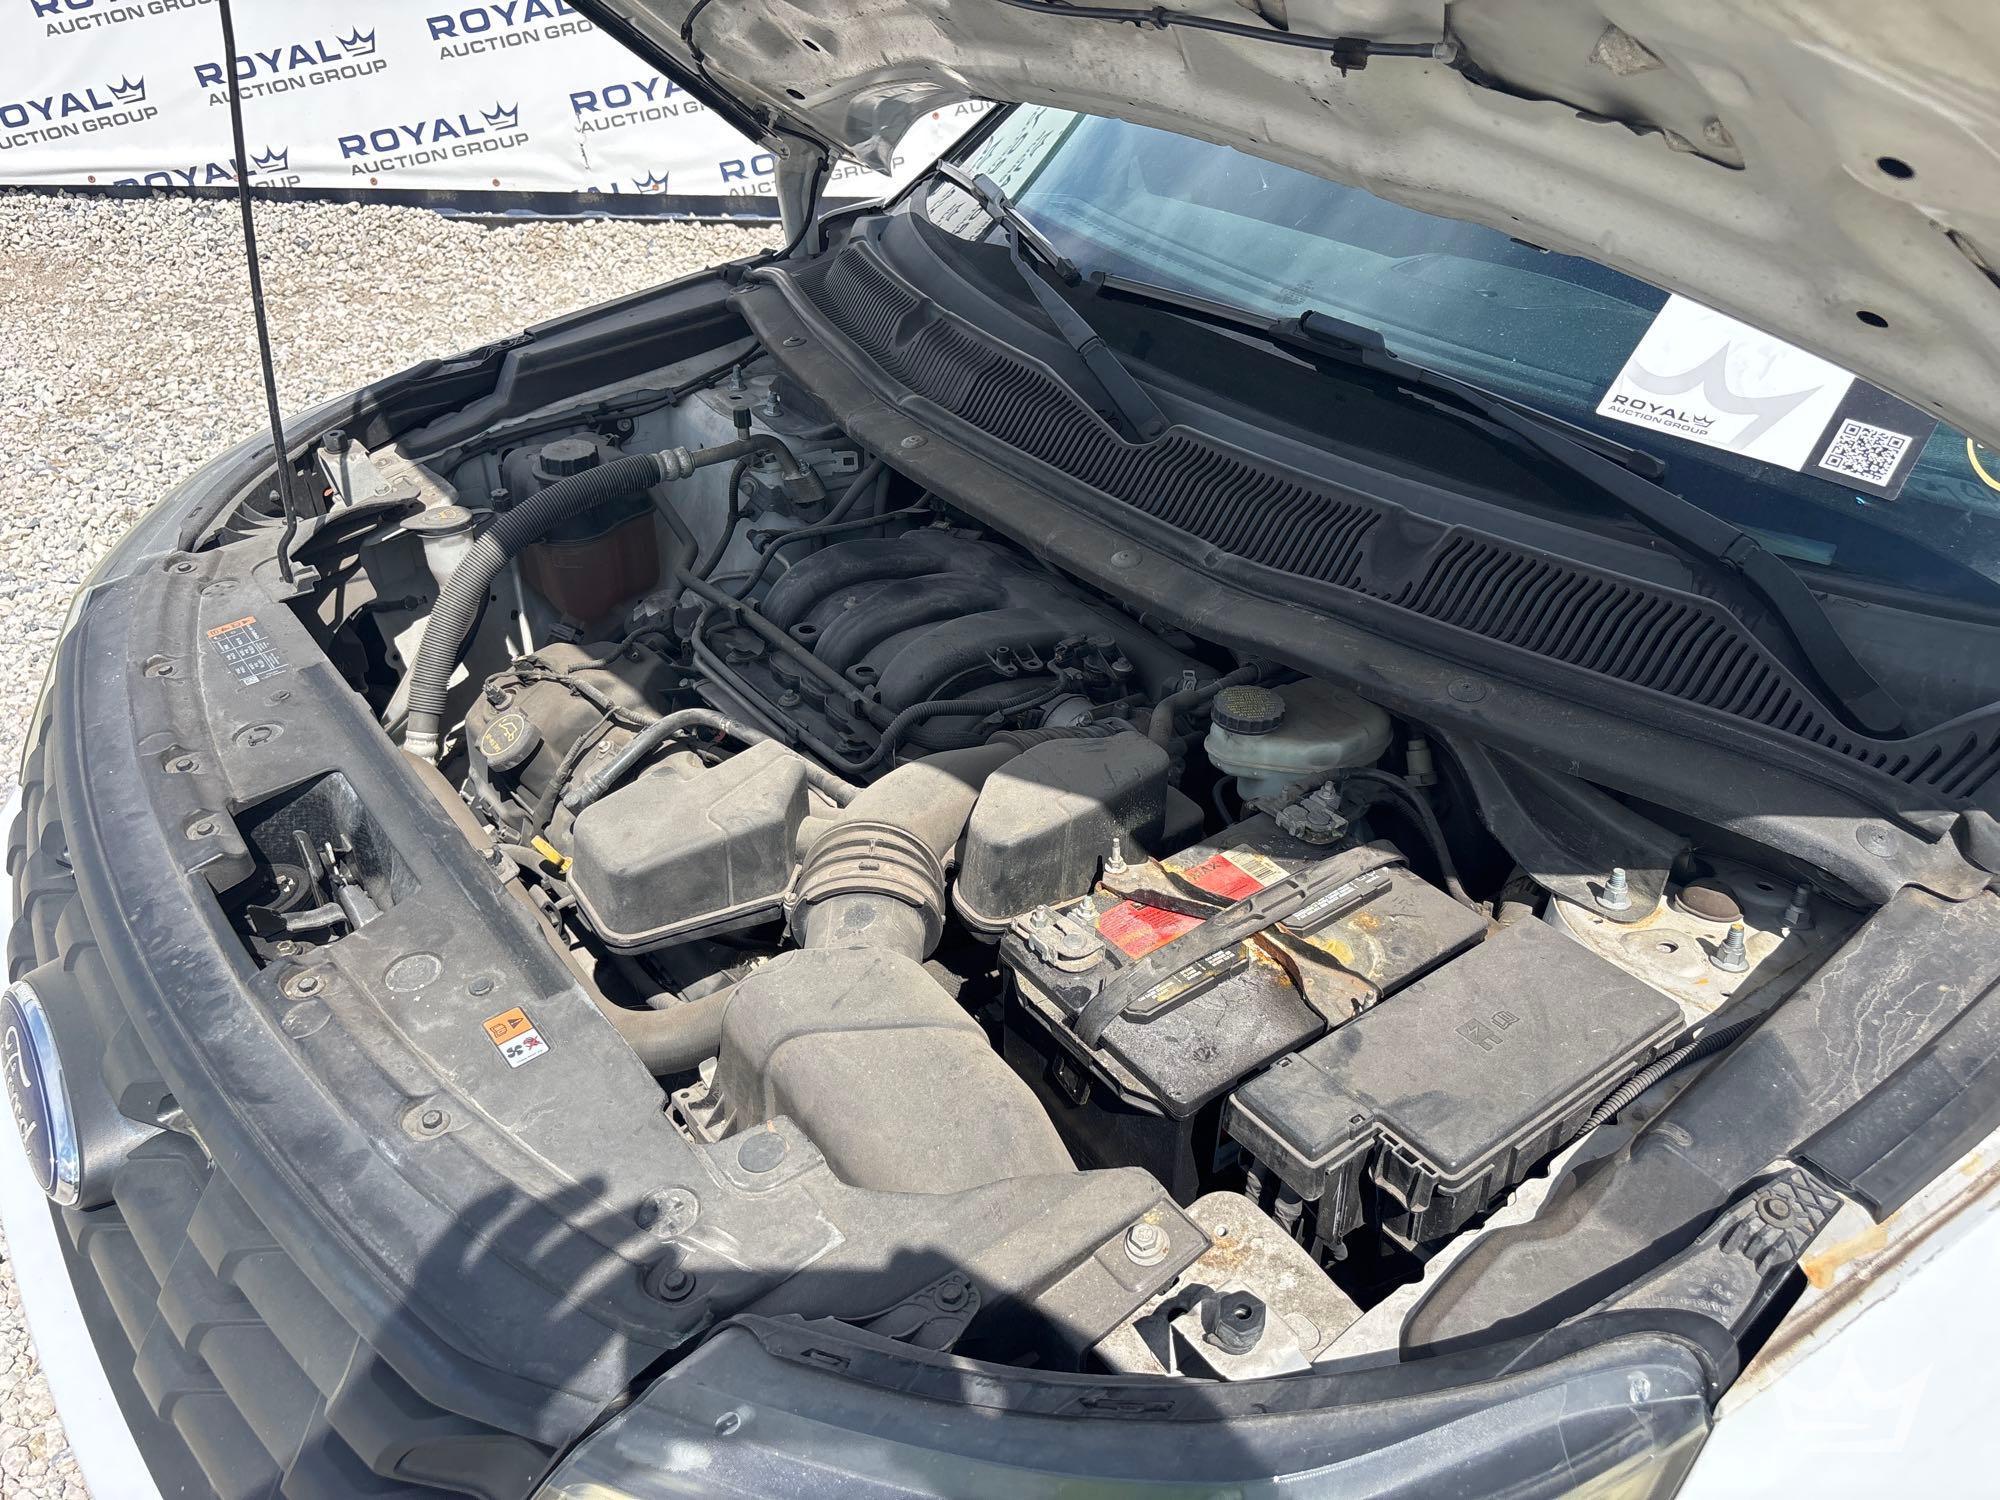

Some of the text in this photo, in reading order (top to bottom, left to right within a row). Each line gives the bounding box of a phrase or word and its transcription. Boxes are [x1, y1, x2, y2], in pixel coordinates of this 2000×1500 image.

[46, 4, 145, 37] AUCTION
[148, 0, 218, 15] GRO
[440, 19, 593, 60] AUCTION GRO
[193, 40, 343, 88] ROYAL
[309, 59, 387, 85] GROUP
[0, 88, 113, 131] OYAL
[569, 77, 685, 116] ROYA
[0, 106, 158, 150] UCTION GROUP
[338, 115, 485, 159] ROYAL
[582, 104, 679, 133] AUCTION
[351, 133, 529, 176] AUCTION GROUP
[1608, 405, 1708, 436] AUCTION GROUP
[1612, 394, 1690, 423] ROYAL
